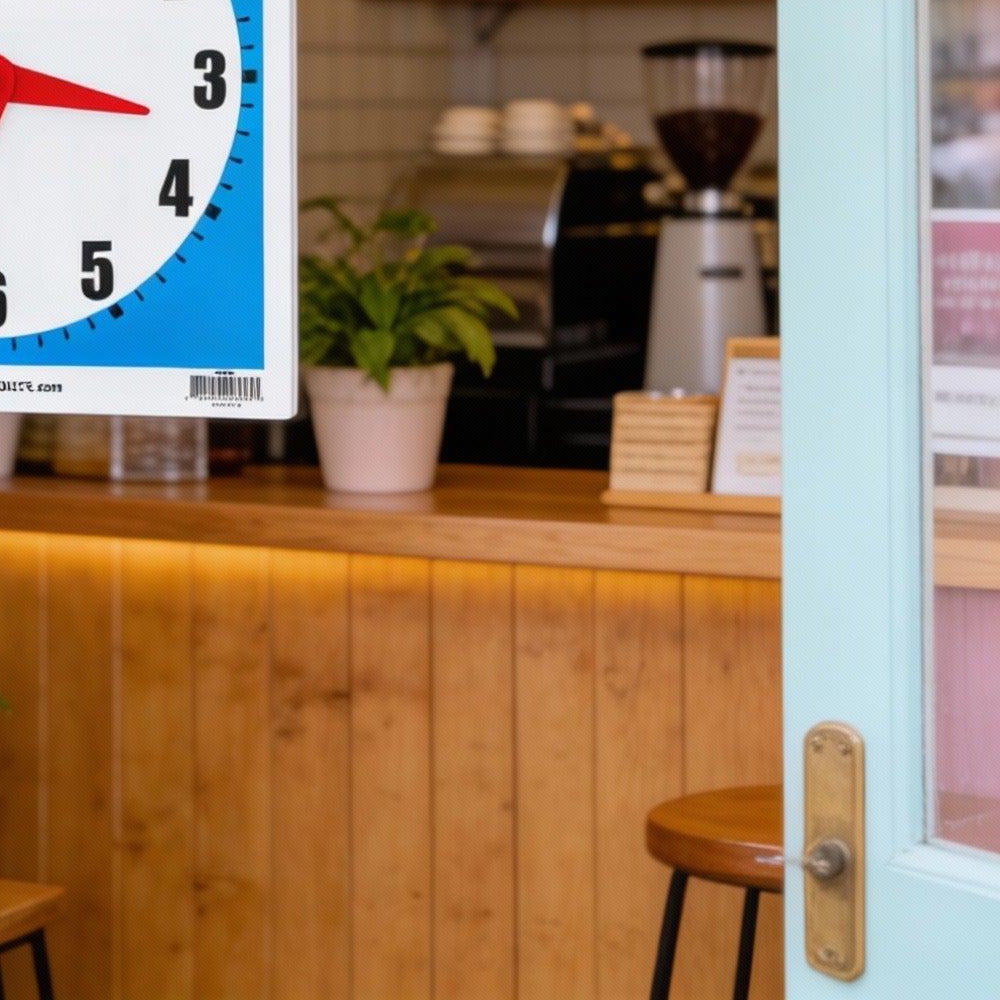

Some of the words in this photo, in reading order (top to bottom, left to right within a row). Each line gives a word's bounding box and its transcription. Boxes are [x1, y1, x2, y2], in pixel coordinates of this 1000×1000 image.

[193, 49, 228, 110] 3
[158, 159, 195, 217] 4
[80, 240, 116, 301] 5
